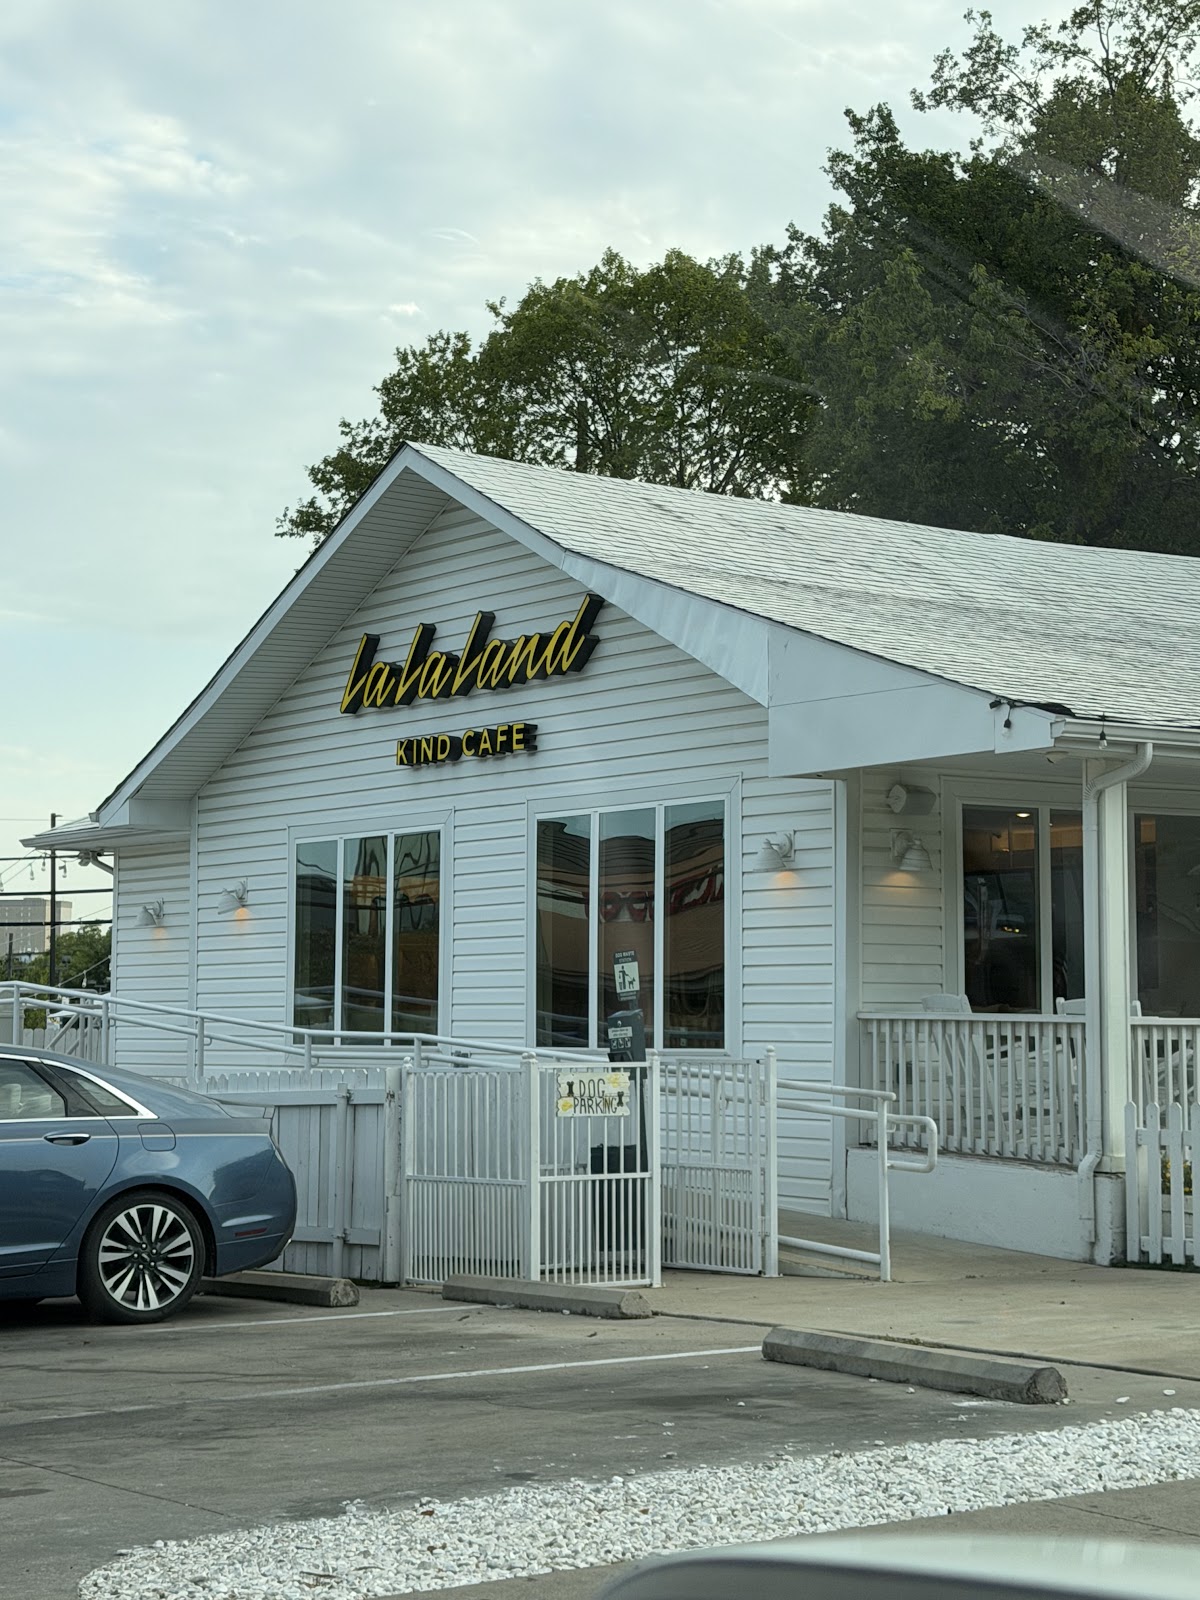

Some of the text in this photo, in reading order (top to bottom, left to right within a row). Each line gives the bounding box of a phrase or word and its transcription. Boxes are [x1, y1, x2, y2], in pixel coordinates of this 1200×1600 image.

[397, 723, 532, 765] KIND CAFE
[578, 1078, 606, 1099] DOG
[573, 1097, 617, 1115] PARKING
